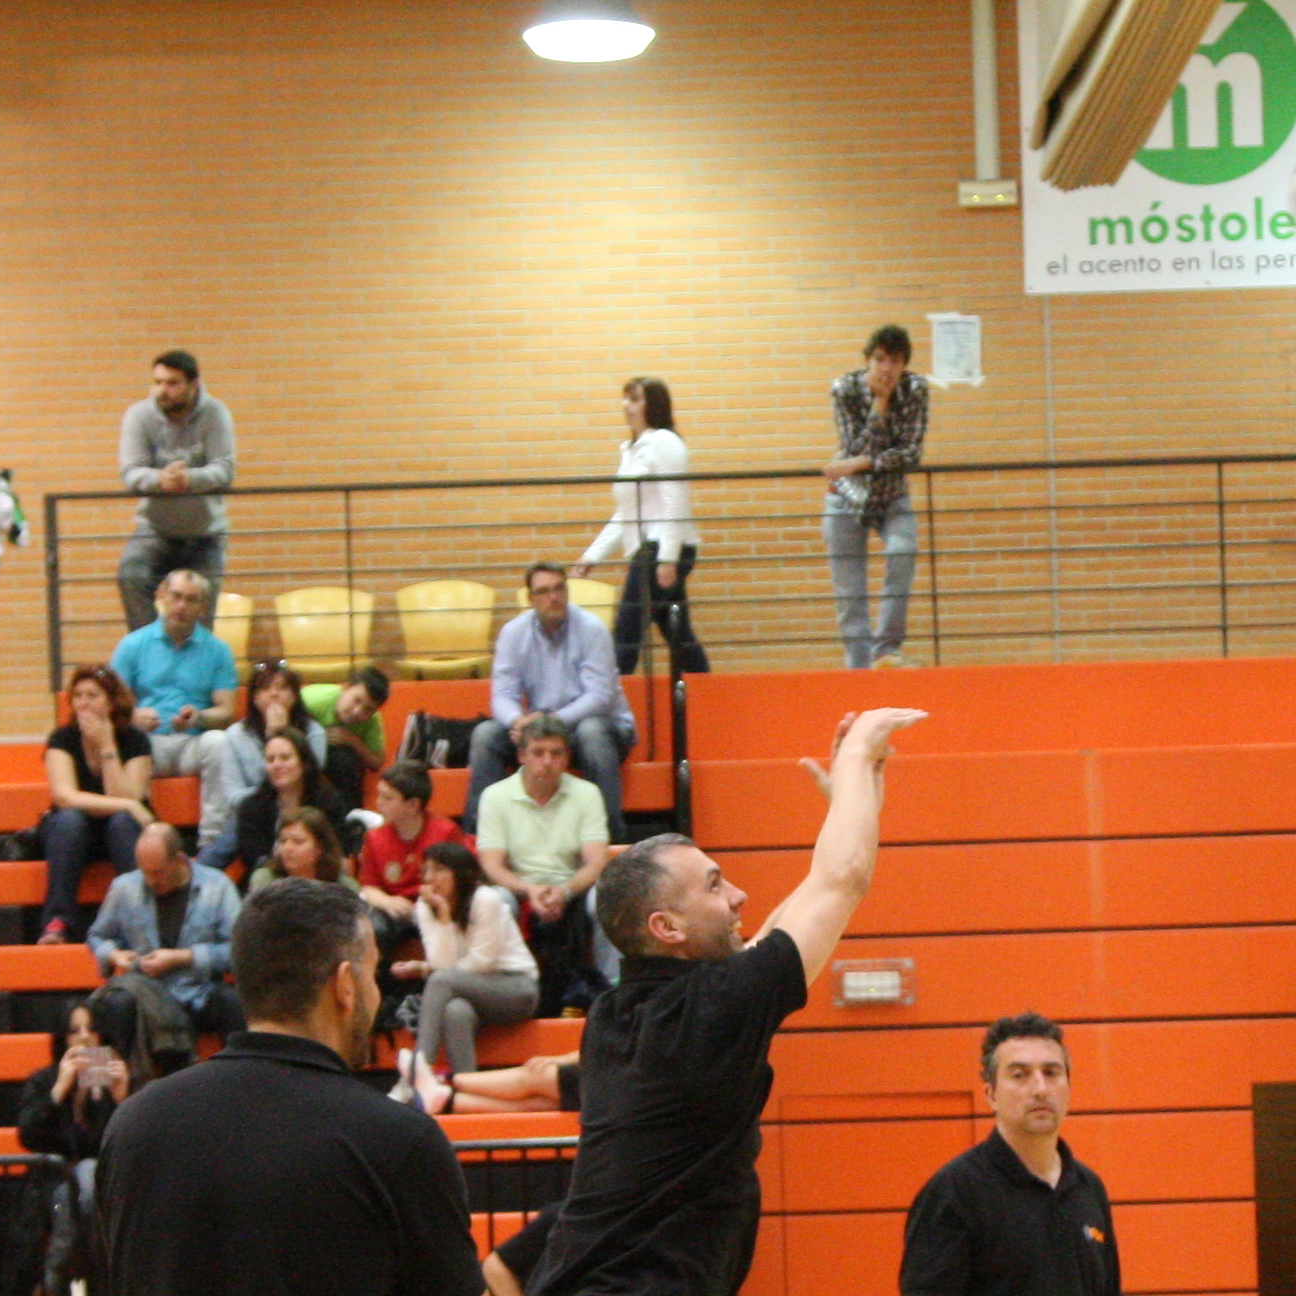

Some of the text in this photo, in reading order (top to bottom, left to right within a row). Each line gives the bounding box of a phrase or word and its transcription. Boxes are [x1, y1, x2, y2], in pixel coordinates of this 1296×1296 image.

[1046, 252, 1068, 275] el
[1079, 254, 1162, 274] acento
[1172, 253, 1201, 273] en
[1211, 250, 1244, 271] las
